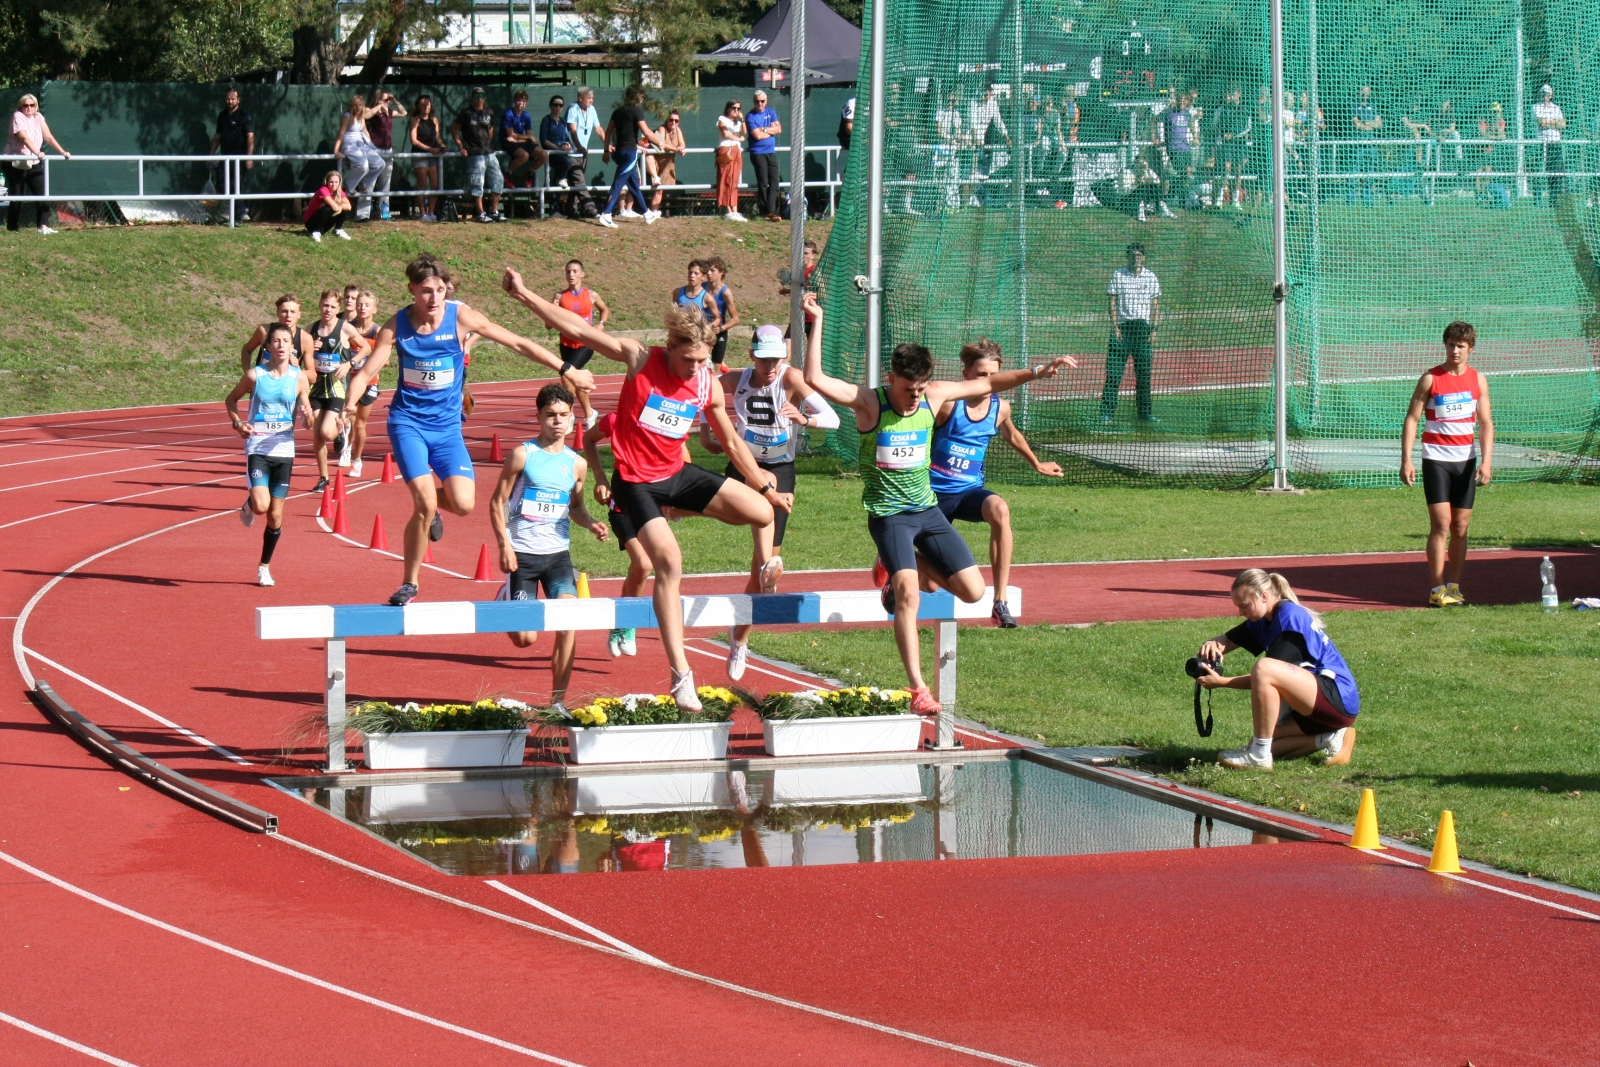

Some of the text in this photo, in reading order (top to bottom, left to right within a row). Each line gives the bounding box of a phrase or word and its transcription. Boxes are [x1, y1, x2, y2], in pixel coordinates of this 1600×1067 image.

[421, 371, 436, 381] 78
[661, 399, 680, 411] ČESKÁ
[1446, 403, 1463, 413] 544
[657, 413, 680, 427] 463
[266, 422, 282, 430] 185
[890, 433, 910, 442] ČESKÁ
[761, 446, 768, 455] 2
[892, 446, 914, 458] 452
[950, 443, 970, 455] ČESKÁ
[947, 456, 970, 470] 418
[537, 502, 555, 513] 181
